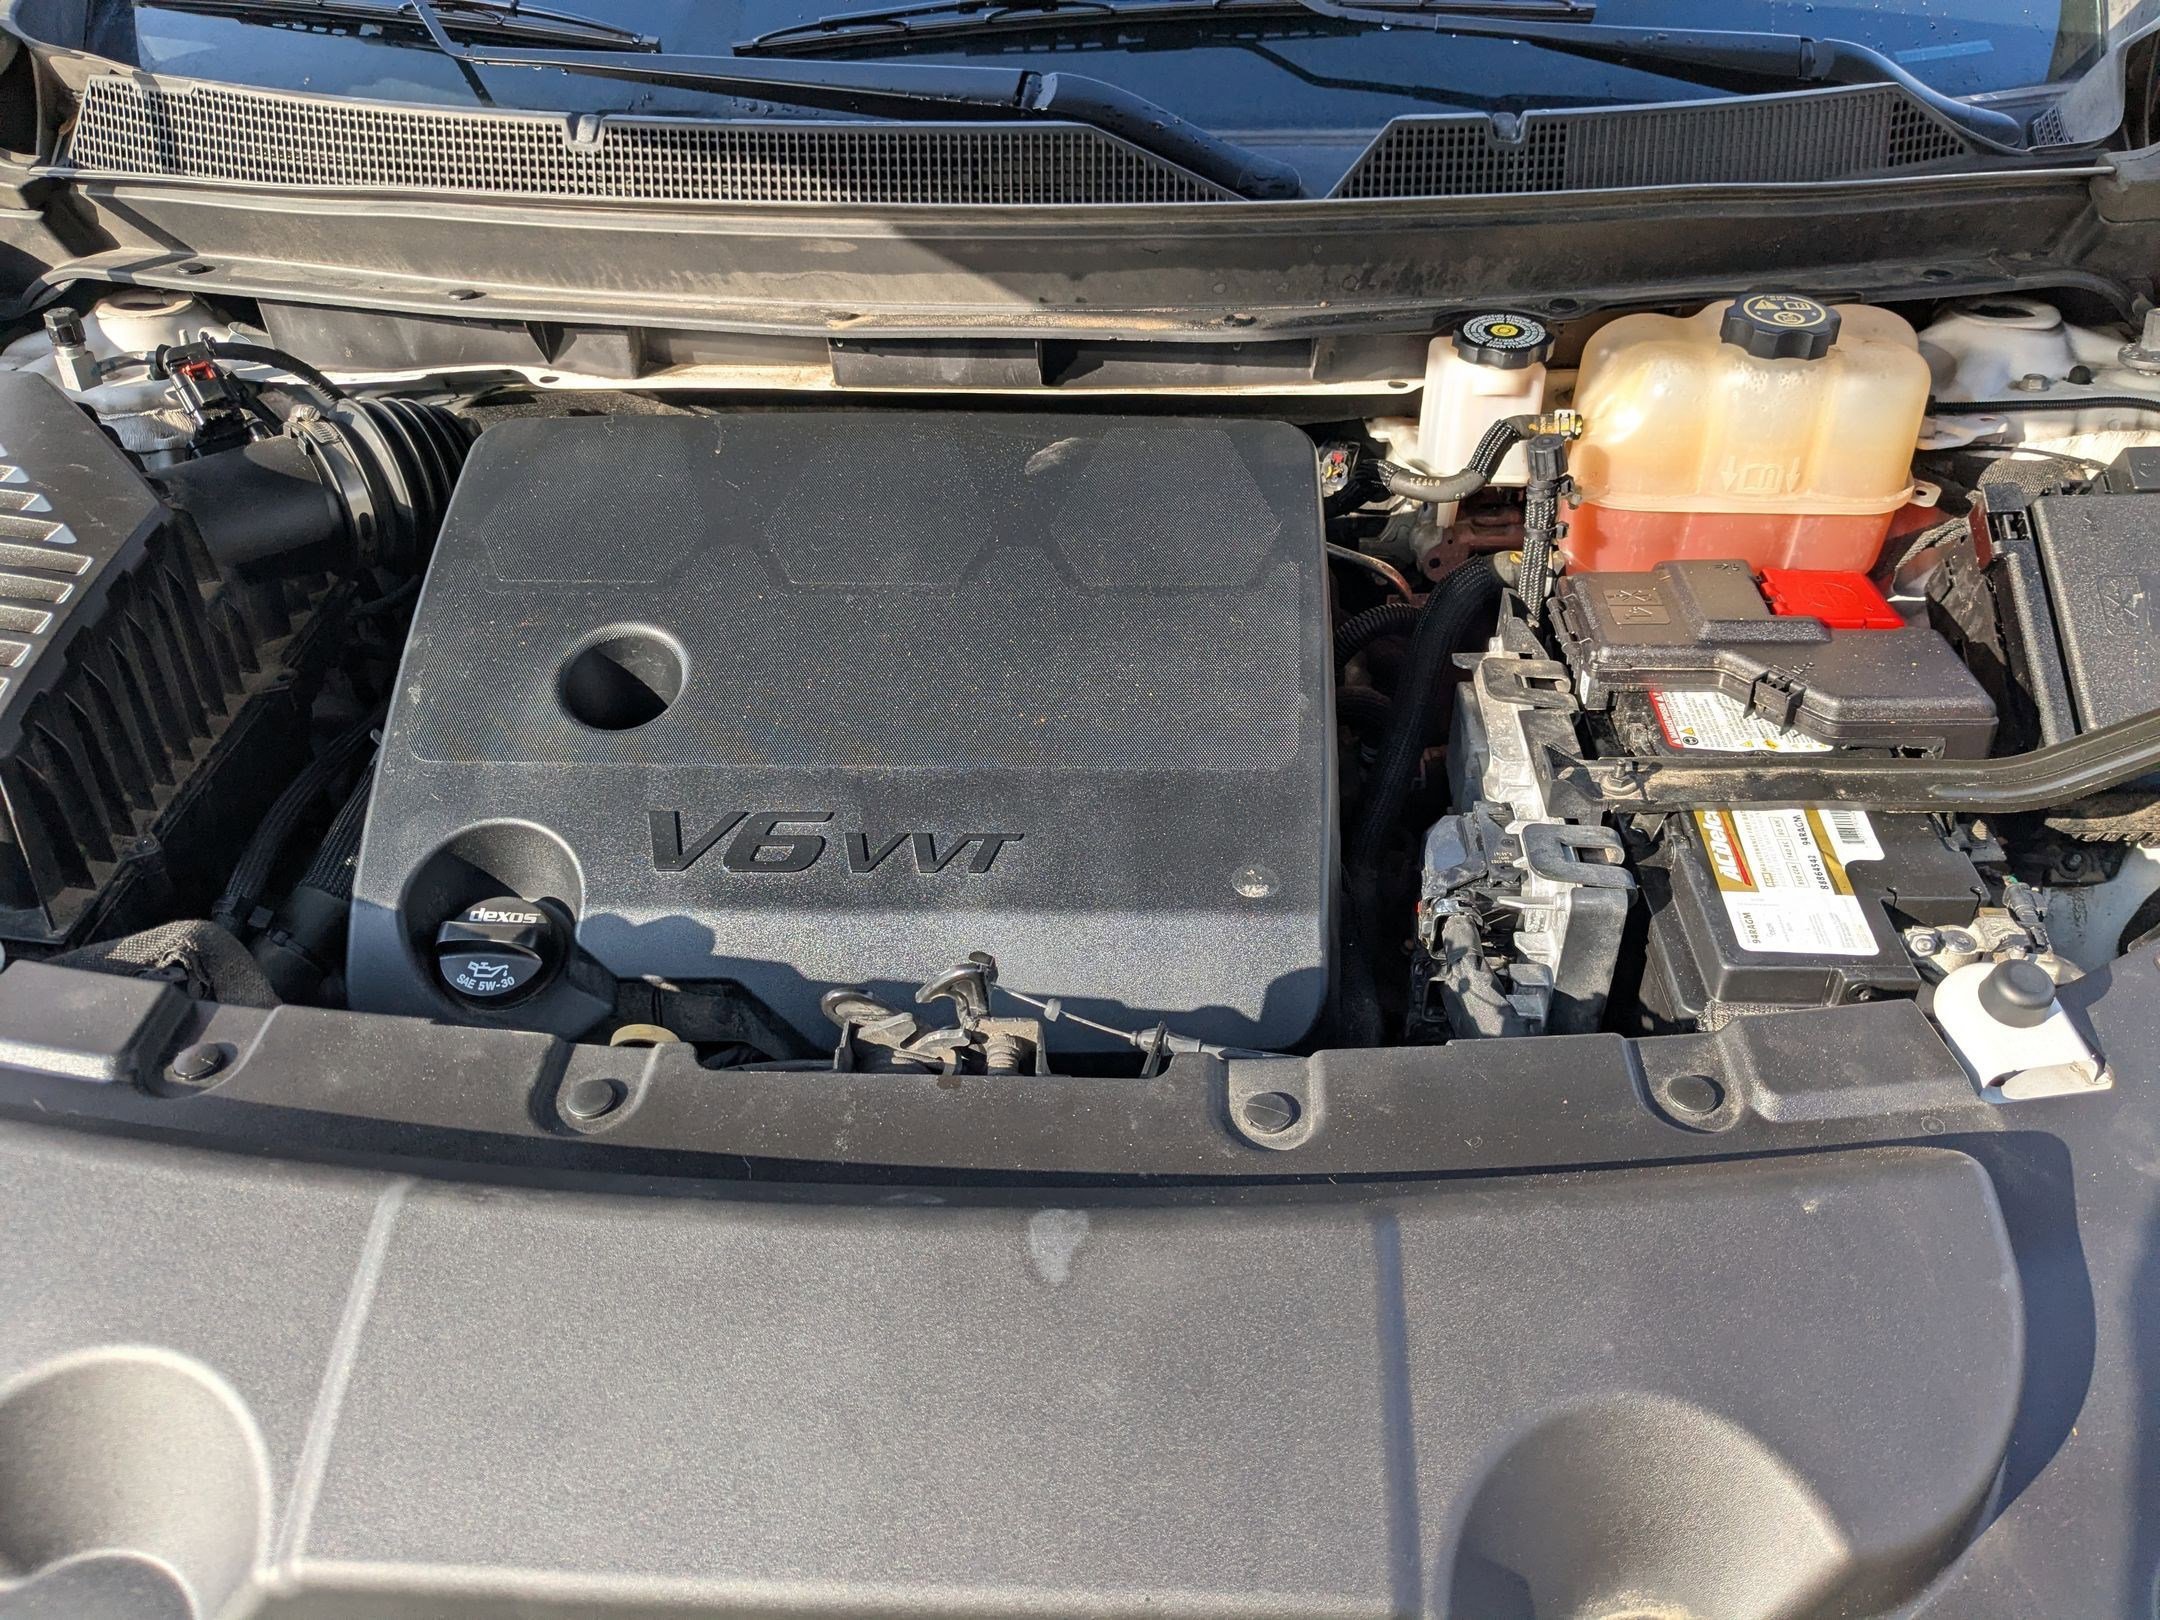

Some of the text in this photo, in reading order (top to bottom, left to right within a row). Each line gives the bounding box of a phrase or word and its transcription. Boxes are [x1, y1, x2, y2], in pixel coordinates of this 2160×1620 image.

[650, 810, 1025, 874] V6 VVT
[1792, 814, 1812, 846] 94RAGM
[1702, 810, 1744, 883] ACDelc
[468, 907, 542, 924] dexos
[1742, 912, 1761, 944] 94RAGM
[456, 973, 515, 991] SAE 5W-30
